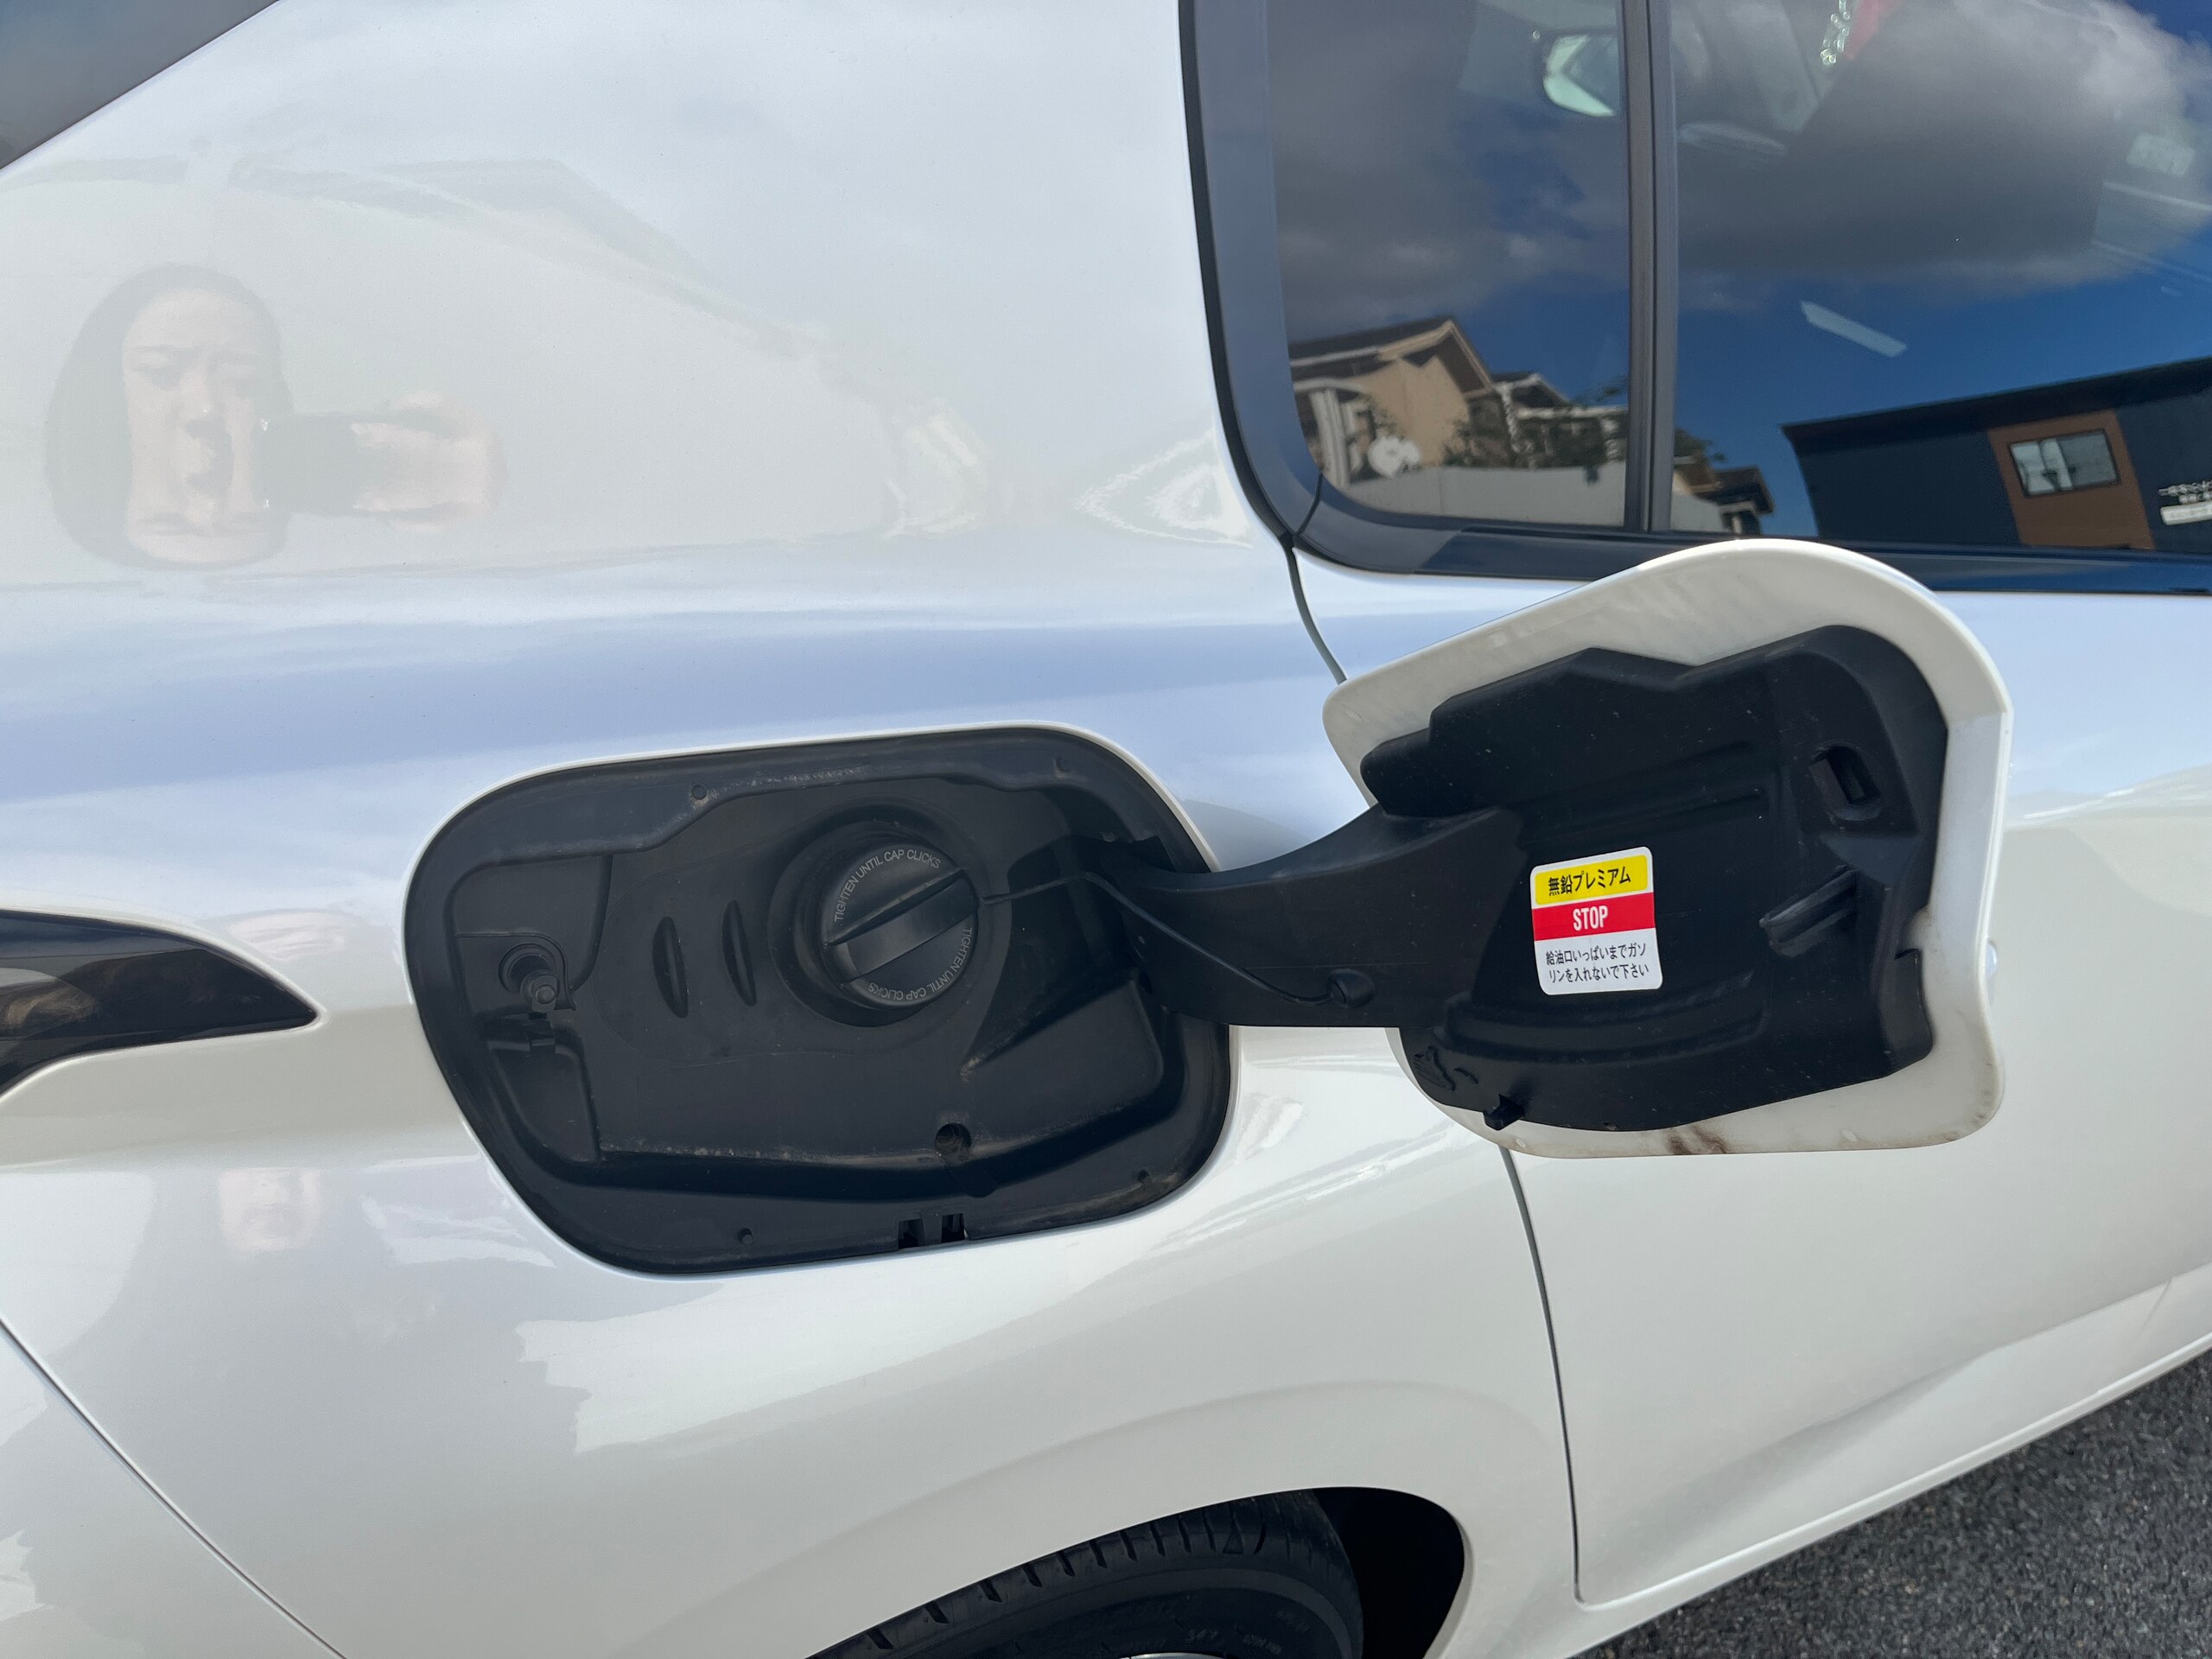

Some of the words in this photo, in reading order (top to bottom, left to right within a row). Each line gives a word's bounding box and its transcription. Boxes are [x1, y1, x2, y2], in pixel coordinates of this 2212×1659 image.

[835, 877, 859, 923] TIGHTEN
[855, 855, 884, 879] UNTIL
[883, 849, 906, 862] CAP
[906, 849, 941, 869] CLICKS
[1548, 866, 1631, 896] 無鉛プレミアム
[1573, 905, 1609, 931] STOP
[950, 926, 974, 973] TIGHTEN
[1546, 943, 1647, 966] 給油口いっぱいまでガソ
[926, 971, 954, 994] UNTIL
[1548, 963, 1649, 984] リンを入れないで下さい
[868, 982, 904, 1001] CLICKS
[906, 987, 927, 1001] CAP
